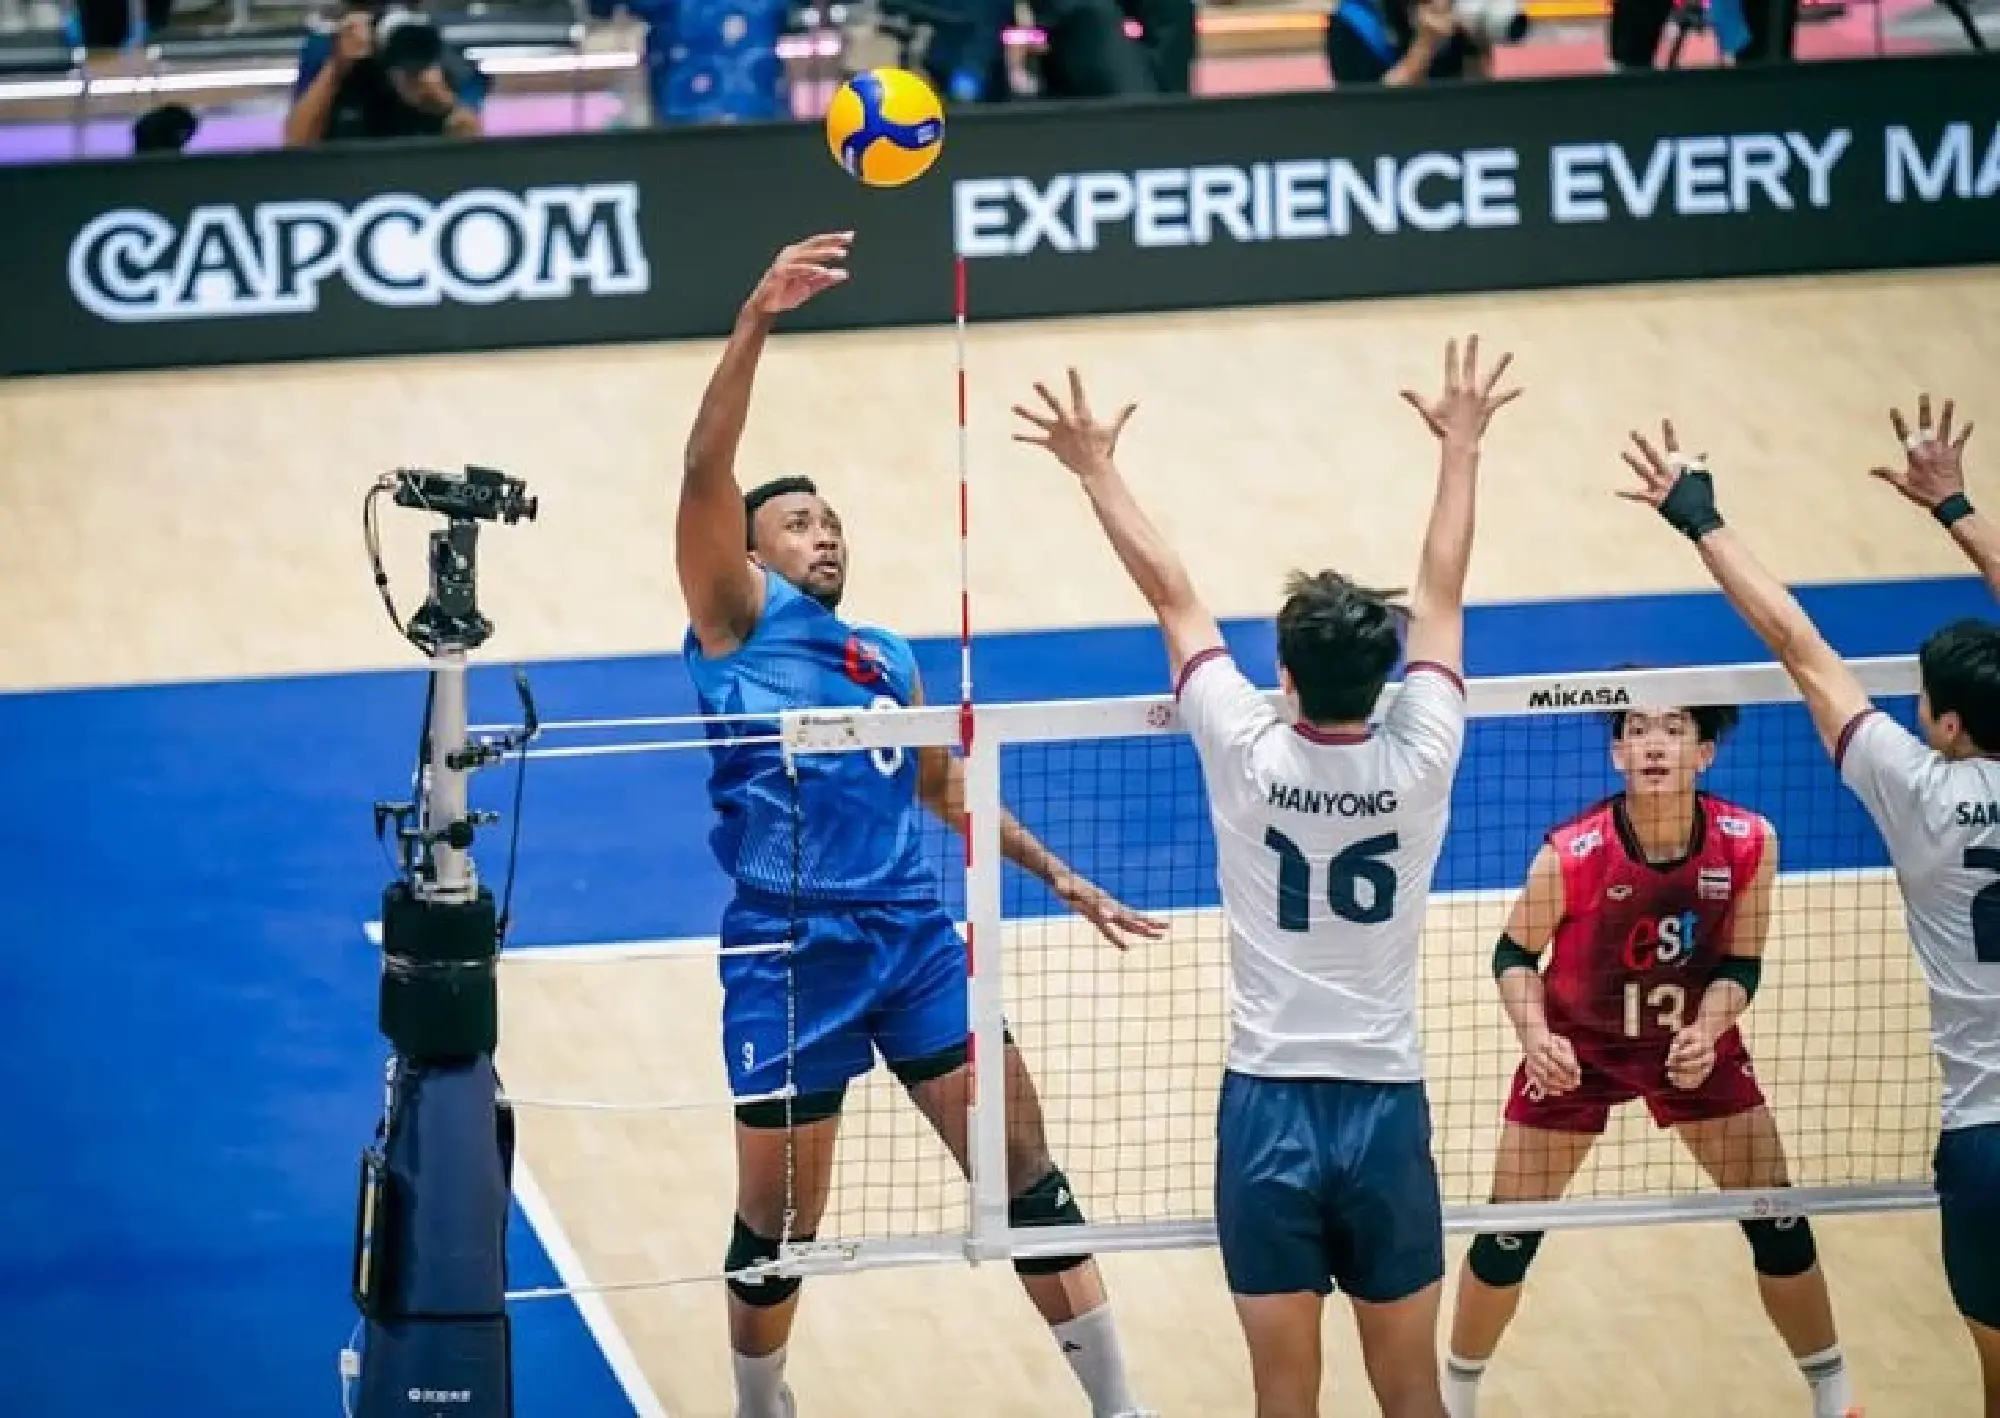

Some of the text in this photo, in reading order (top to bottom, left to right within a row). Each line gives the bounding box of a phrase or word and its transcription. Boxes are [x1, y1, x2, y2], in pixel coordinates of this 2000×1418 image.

[954, 148, 1520, 256] EXPERIENCE
[1549, 128, 1853, 223] EVERY
[69, 183, 649, 321] CAPCOM
[1268, 783, 1398, 818] HANYONG
[1264, 825, 1400, 932] 16
[1621, 911, 1699, 970] est
